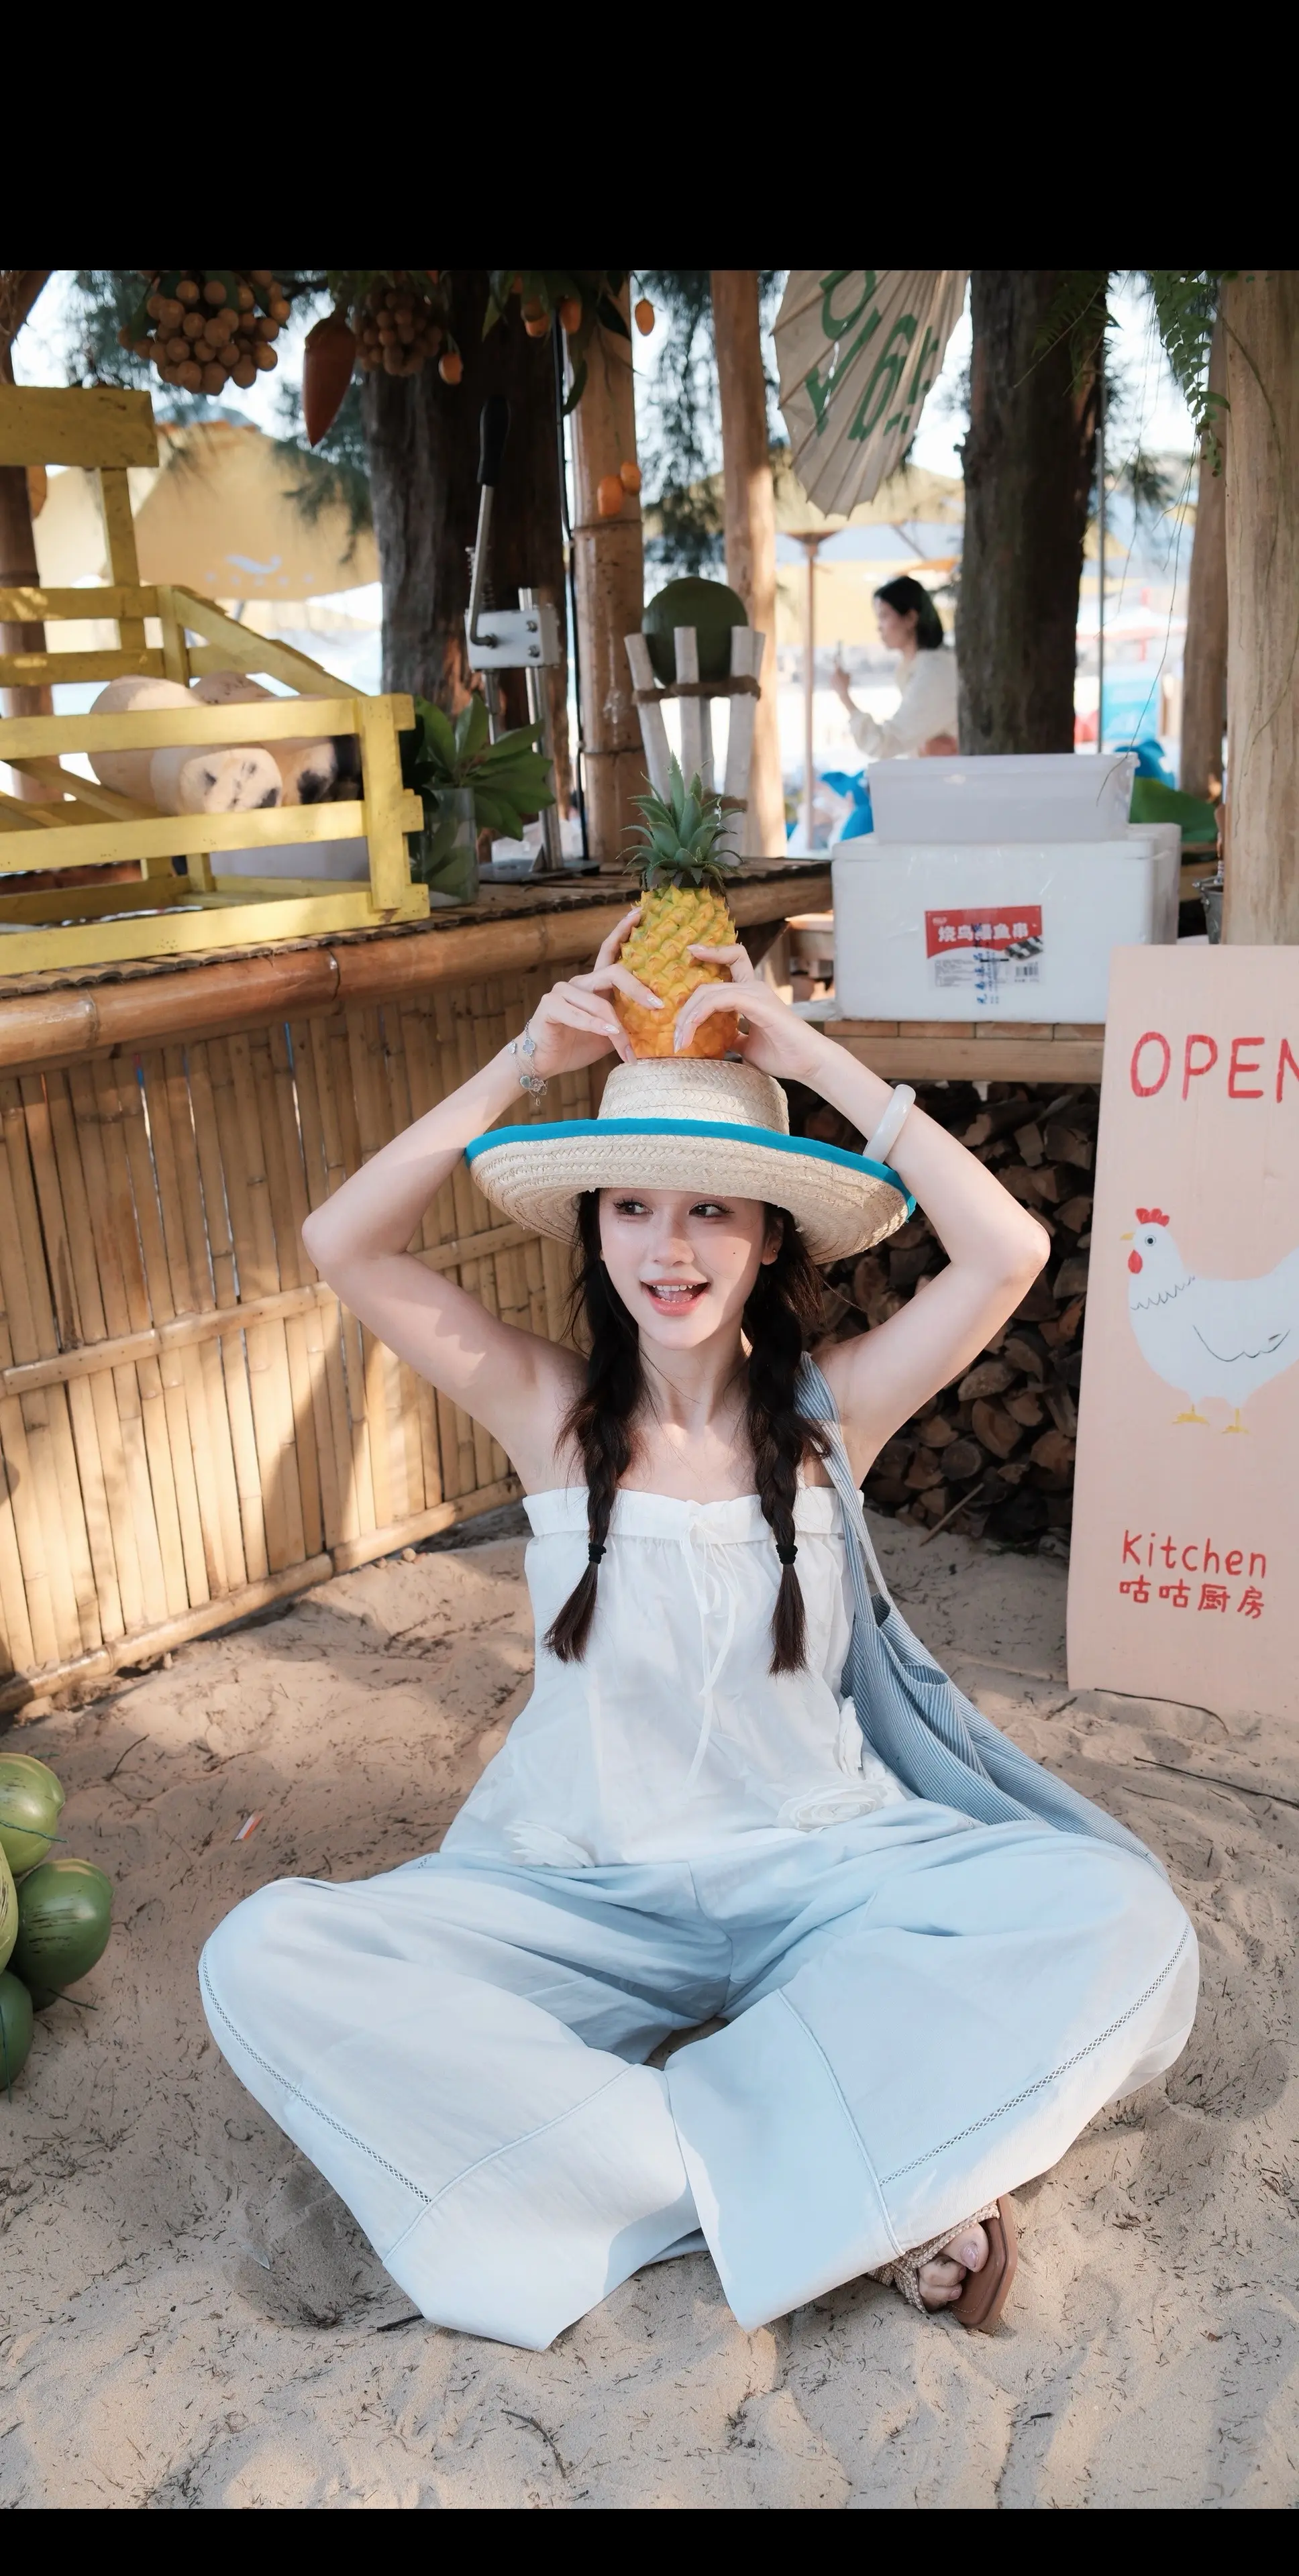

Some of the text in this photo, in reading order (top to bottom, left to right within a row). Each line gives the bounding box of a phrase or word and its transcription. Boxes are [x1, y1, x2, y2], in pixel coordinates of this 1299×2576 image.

[1123, 1529, 1267, 1578] Kitchen
[1119, 1574, 1265, 1619] 咕咕厨房
